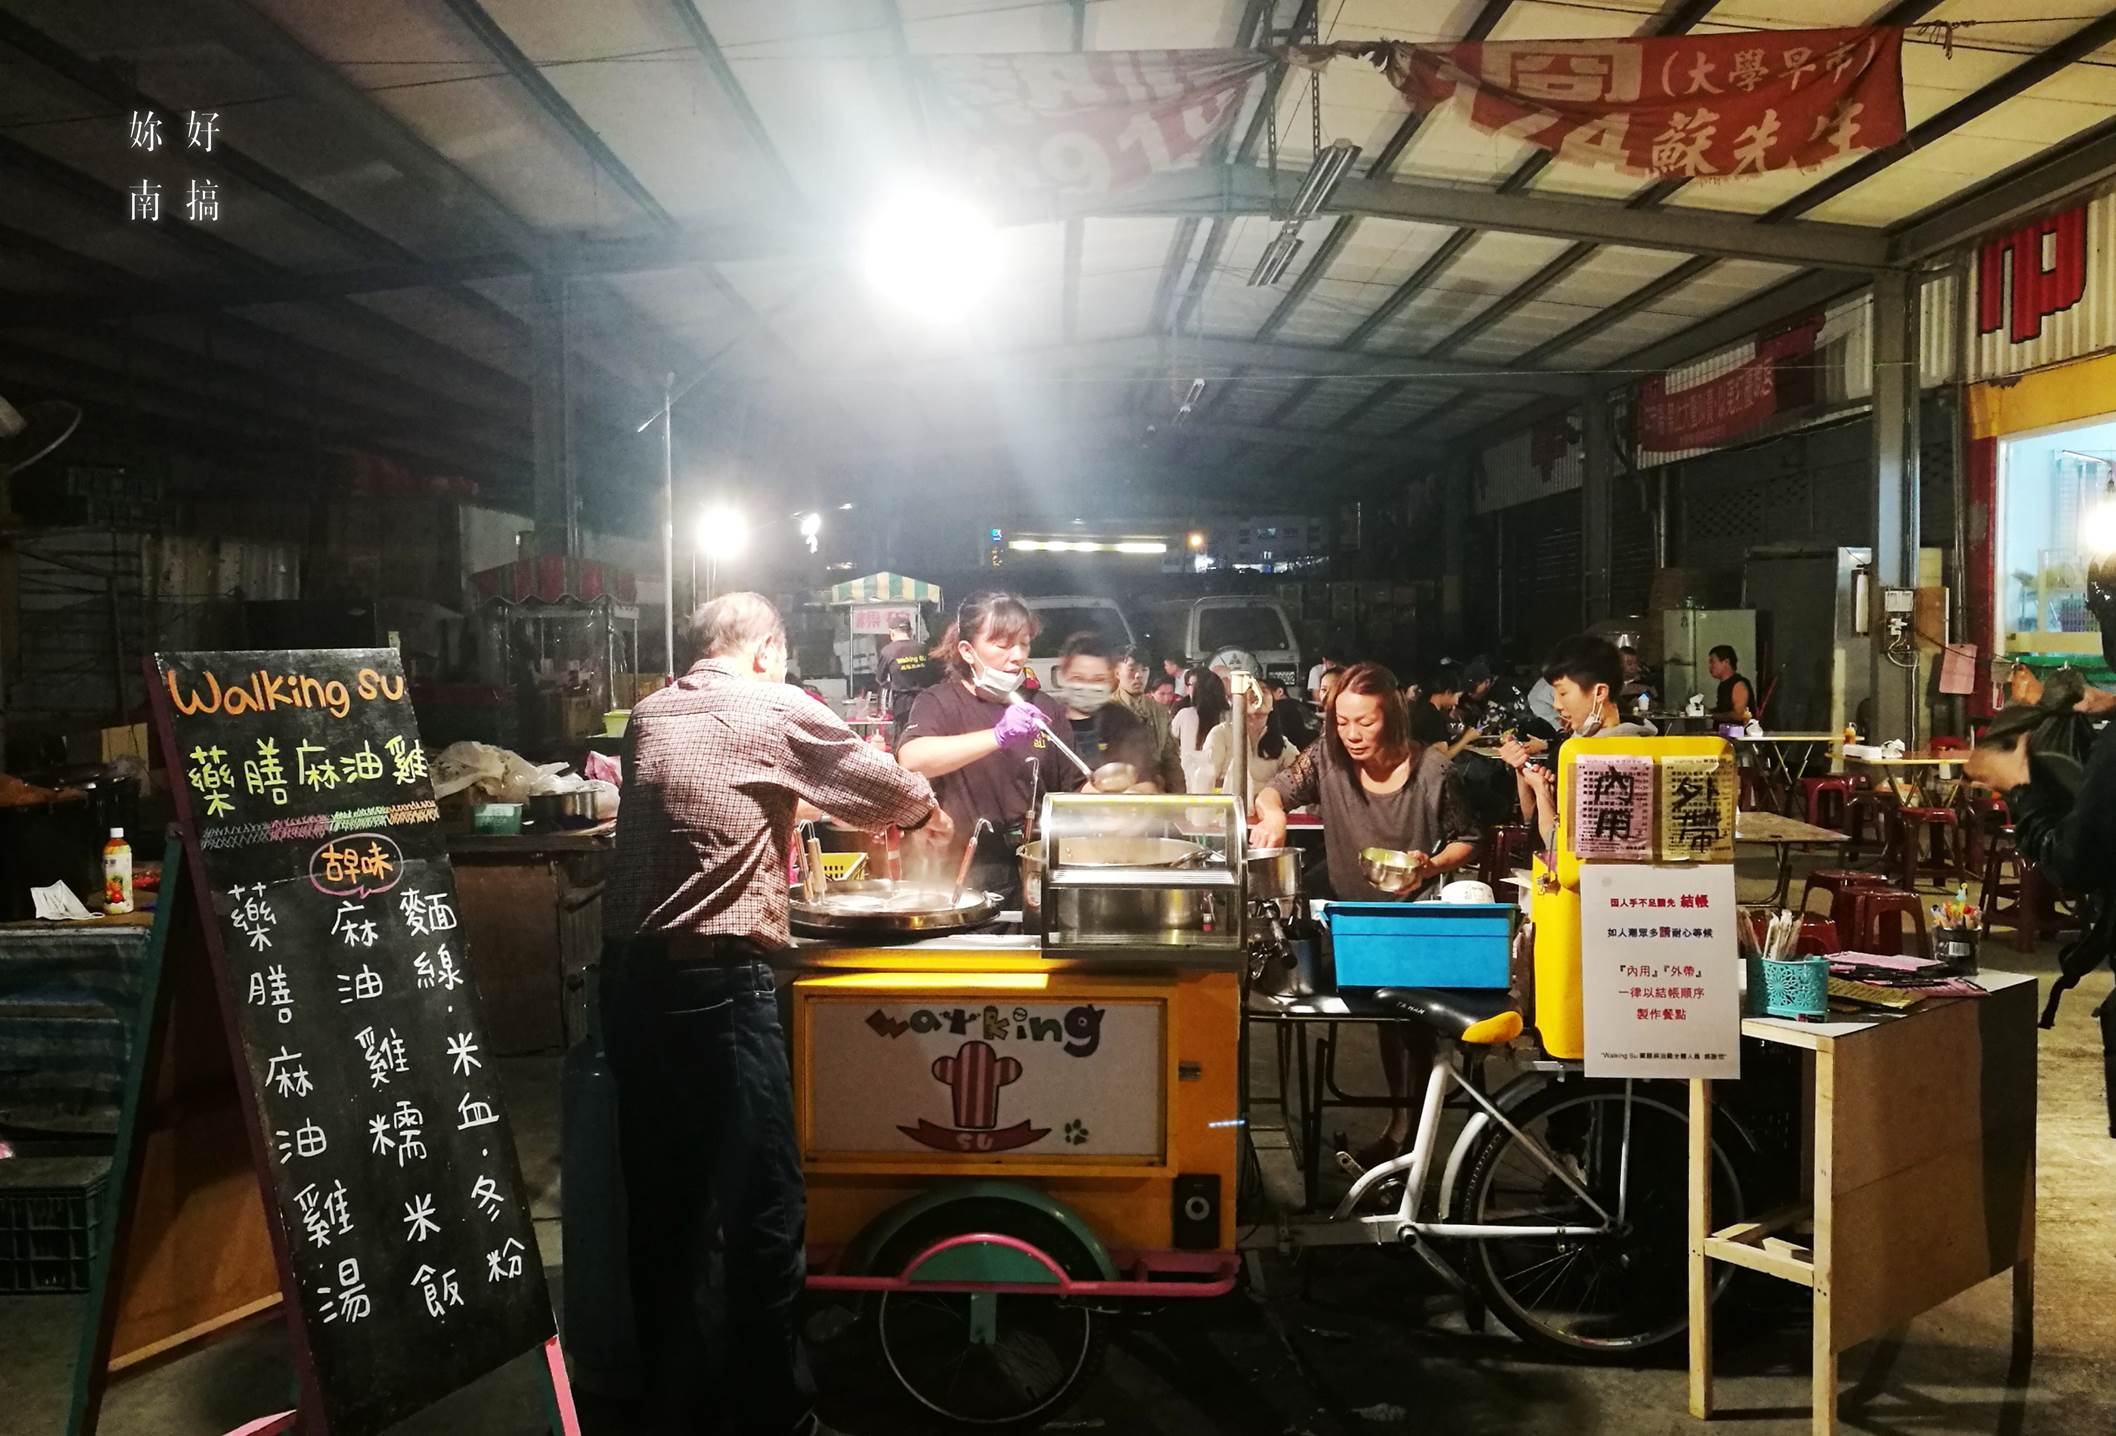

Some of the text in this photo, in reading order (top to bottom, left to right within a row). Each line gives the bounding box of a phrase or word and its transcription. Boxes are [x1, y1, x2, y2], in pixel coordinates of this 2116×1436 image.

[1651, 101, 1873, 178] 蘇先生
[168, 669, 350, 718] Walking
[188, 735, 428, 819] 藥膳麻油雞
[1672, 776, 1723, 854] 外帶
[321, 840, 394, 887] 古早味
[1680, 893, 1710, 909] 結帳
[1618, 986, 1706, 1000] 一律以結帳順序
[1636, 1007, 1687, 1021] 製作餐點
[226, 881, 372, 1324] 藥膳麻油雞湯
[330, 900, 466, 1317] 麻油雞糯米飯
